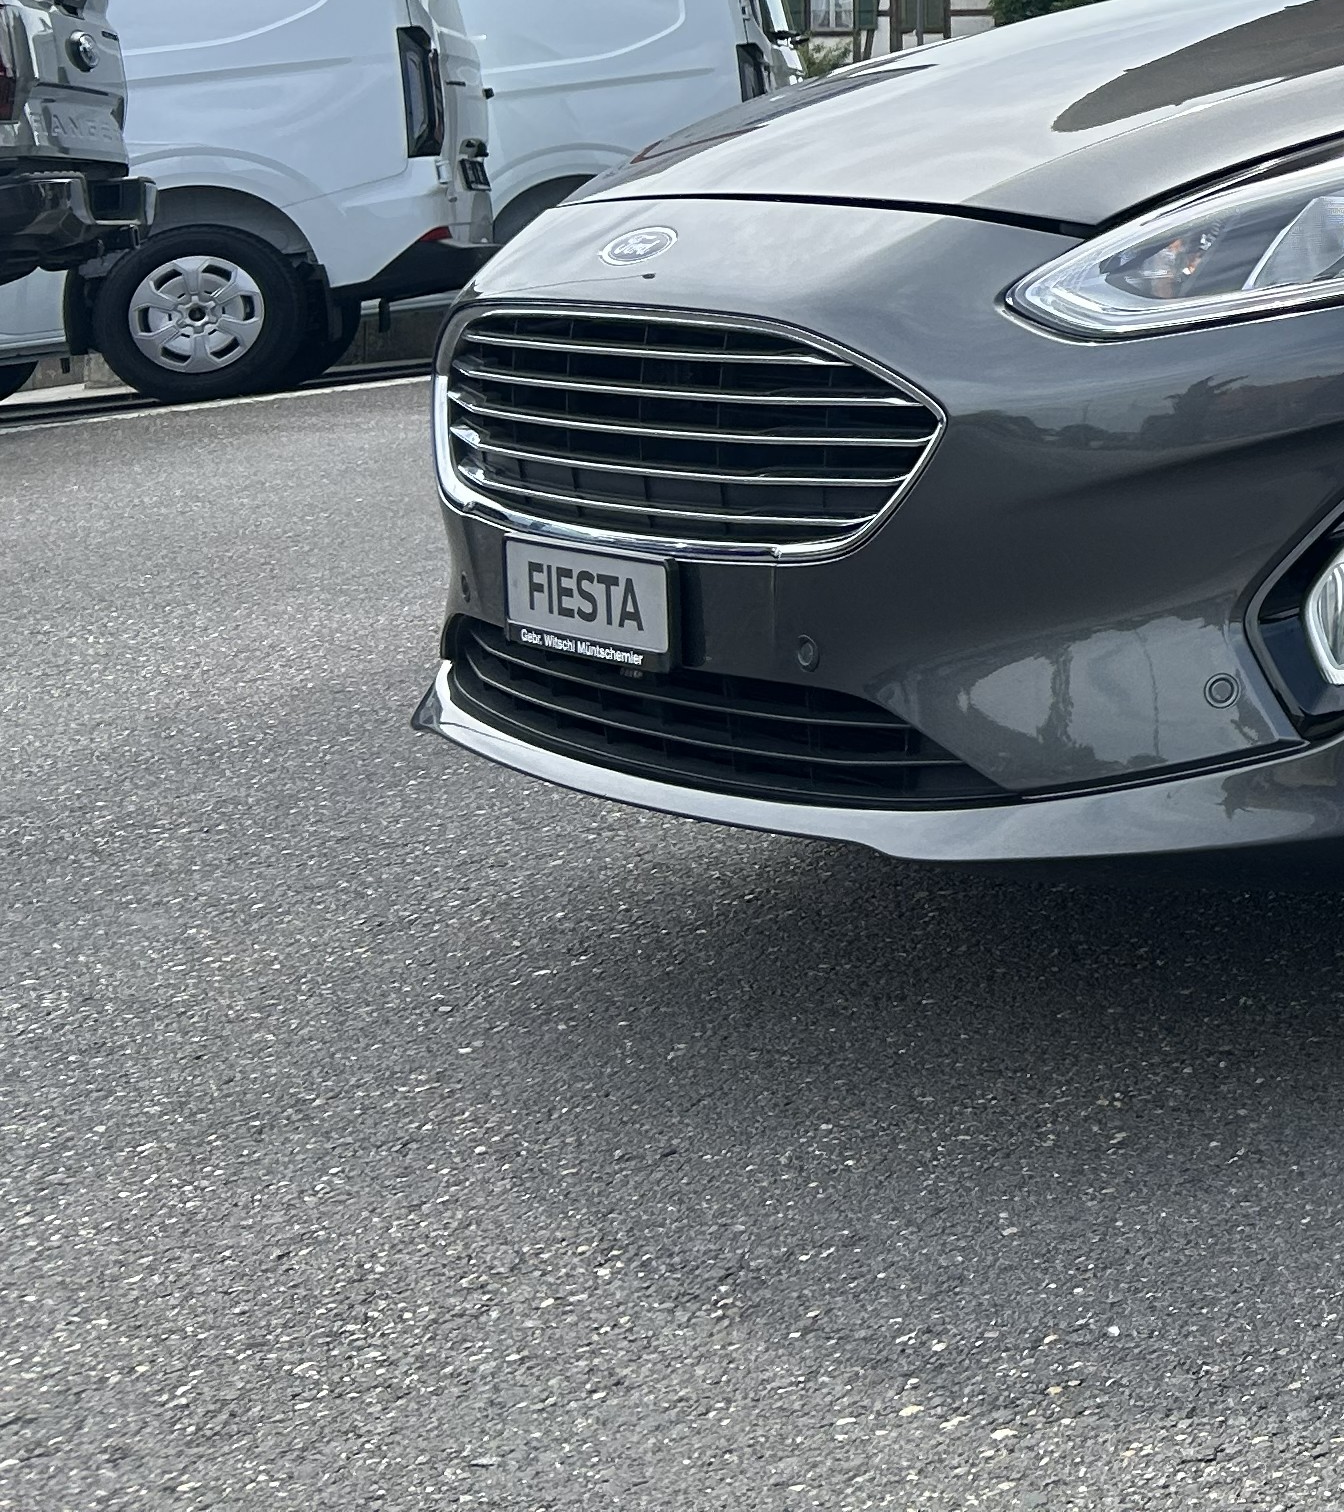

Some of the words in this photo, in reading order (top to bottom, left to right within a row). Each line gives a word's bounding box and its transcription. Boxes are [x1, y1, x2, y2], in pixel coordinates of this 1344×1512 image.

[613, 234, 660, 255] Ford
[528, 561, 645, 631] FIESTA
[521, 629, 543, 645] Gebr.
[543, 633, 576, 652] Witschi
